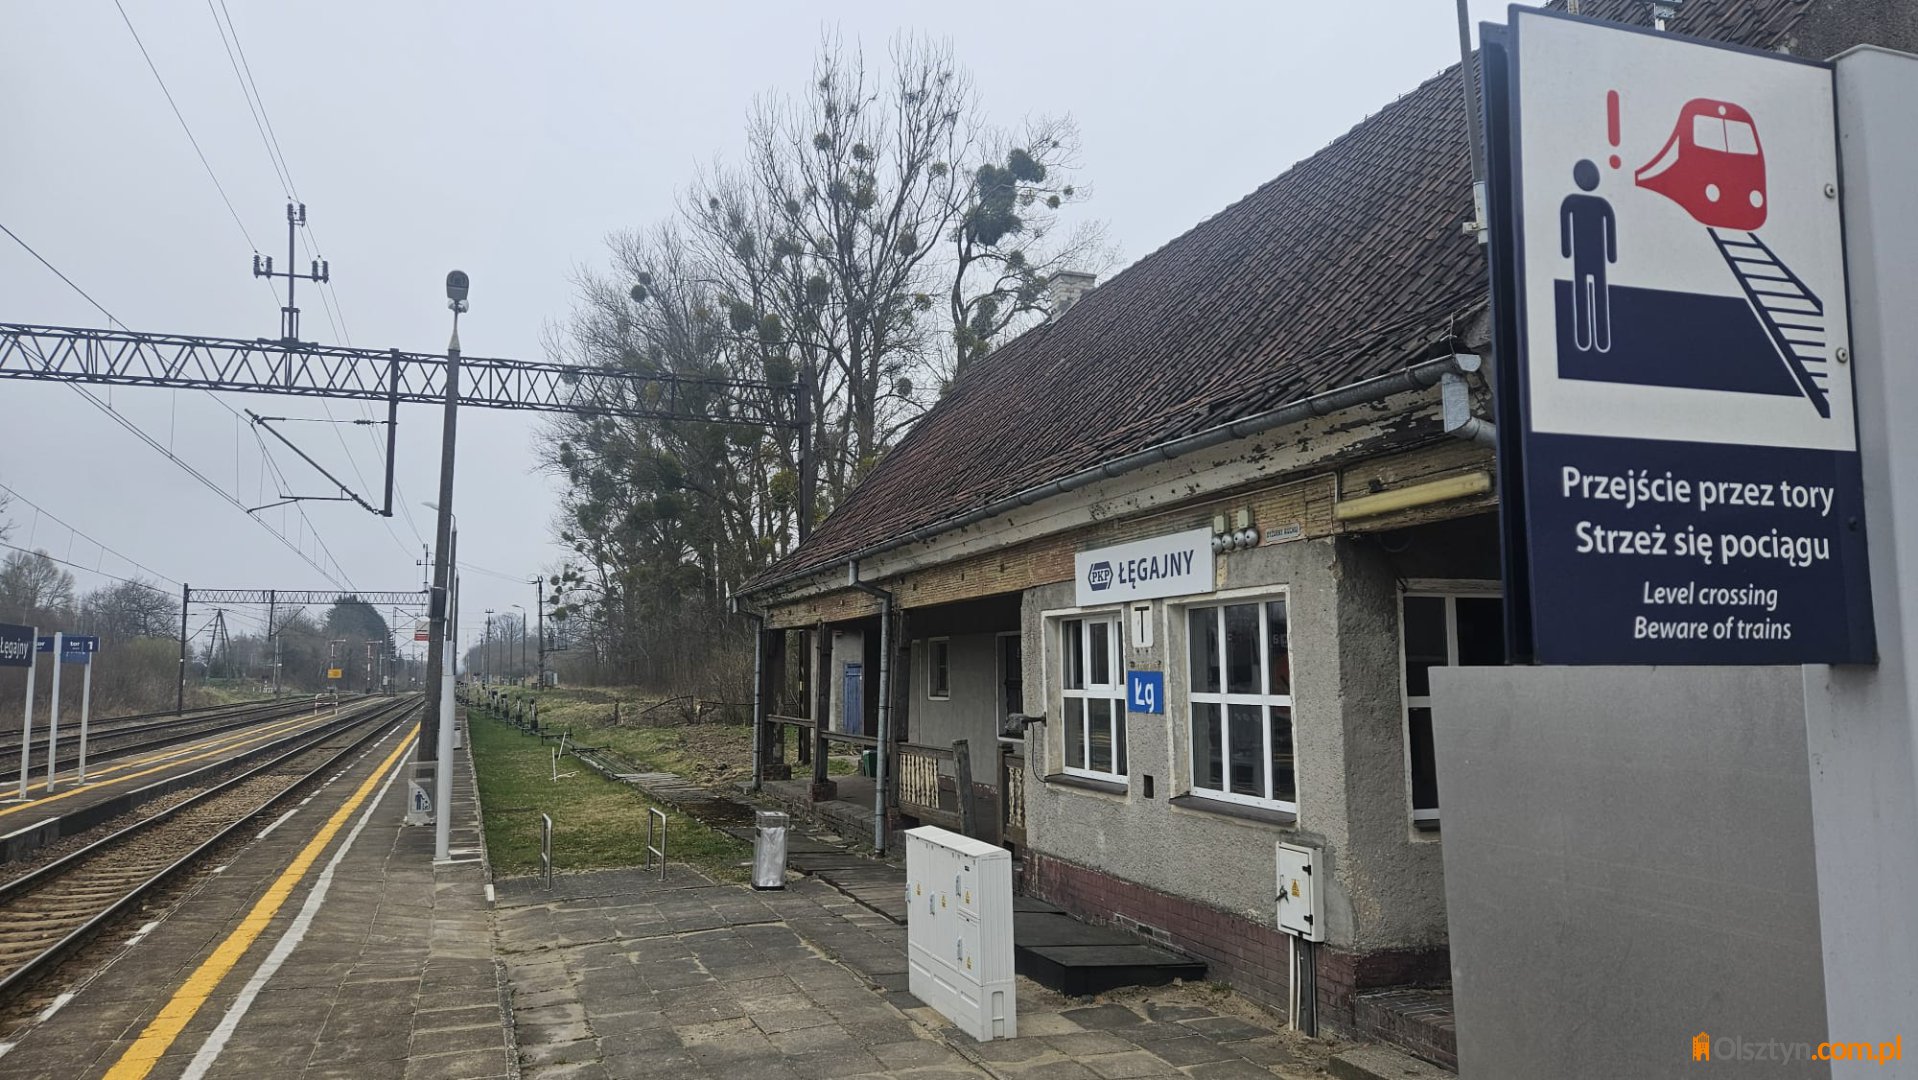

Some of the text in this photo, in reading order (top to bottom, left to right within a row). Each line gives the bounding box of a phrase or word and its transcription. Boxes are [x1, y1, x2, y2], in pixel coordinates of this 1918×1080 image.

[1562, 466, 1834, 516] Przejście przez tory
[1576, 521, 1830, 567] Strzeż się pociągu
[1092, 549, 1194, 589] PKP ŁĘGAJNY
[1643, 581, 1778, 611] Level crossing
[1134, 606, 1150, 643] T
[1634, 615, 1791, 640] Beware of trains
[87, 641, 93, 650] 1
[1135, 677, 1155, 714] Łg
